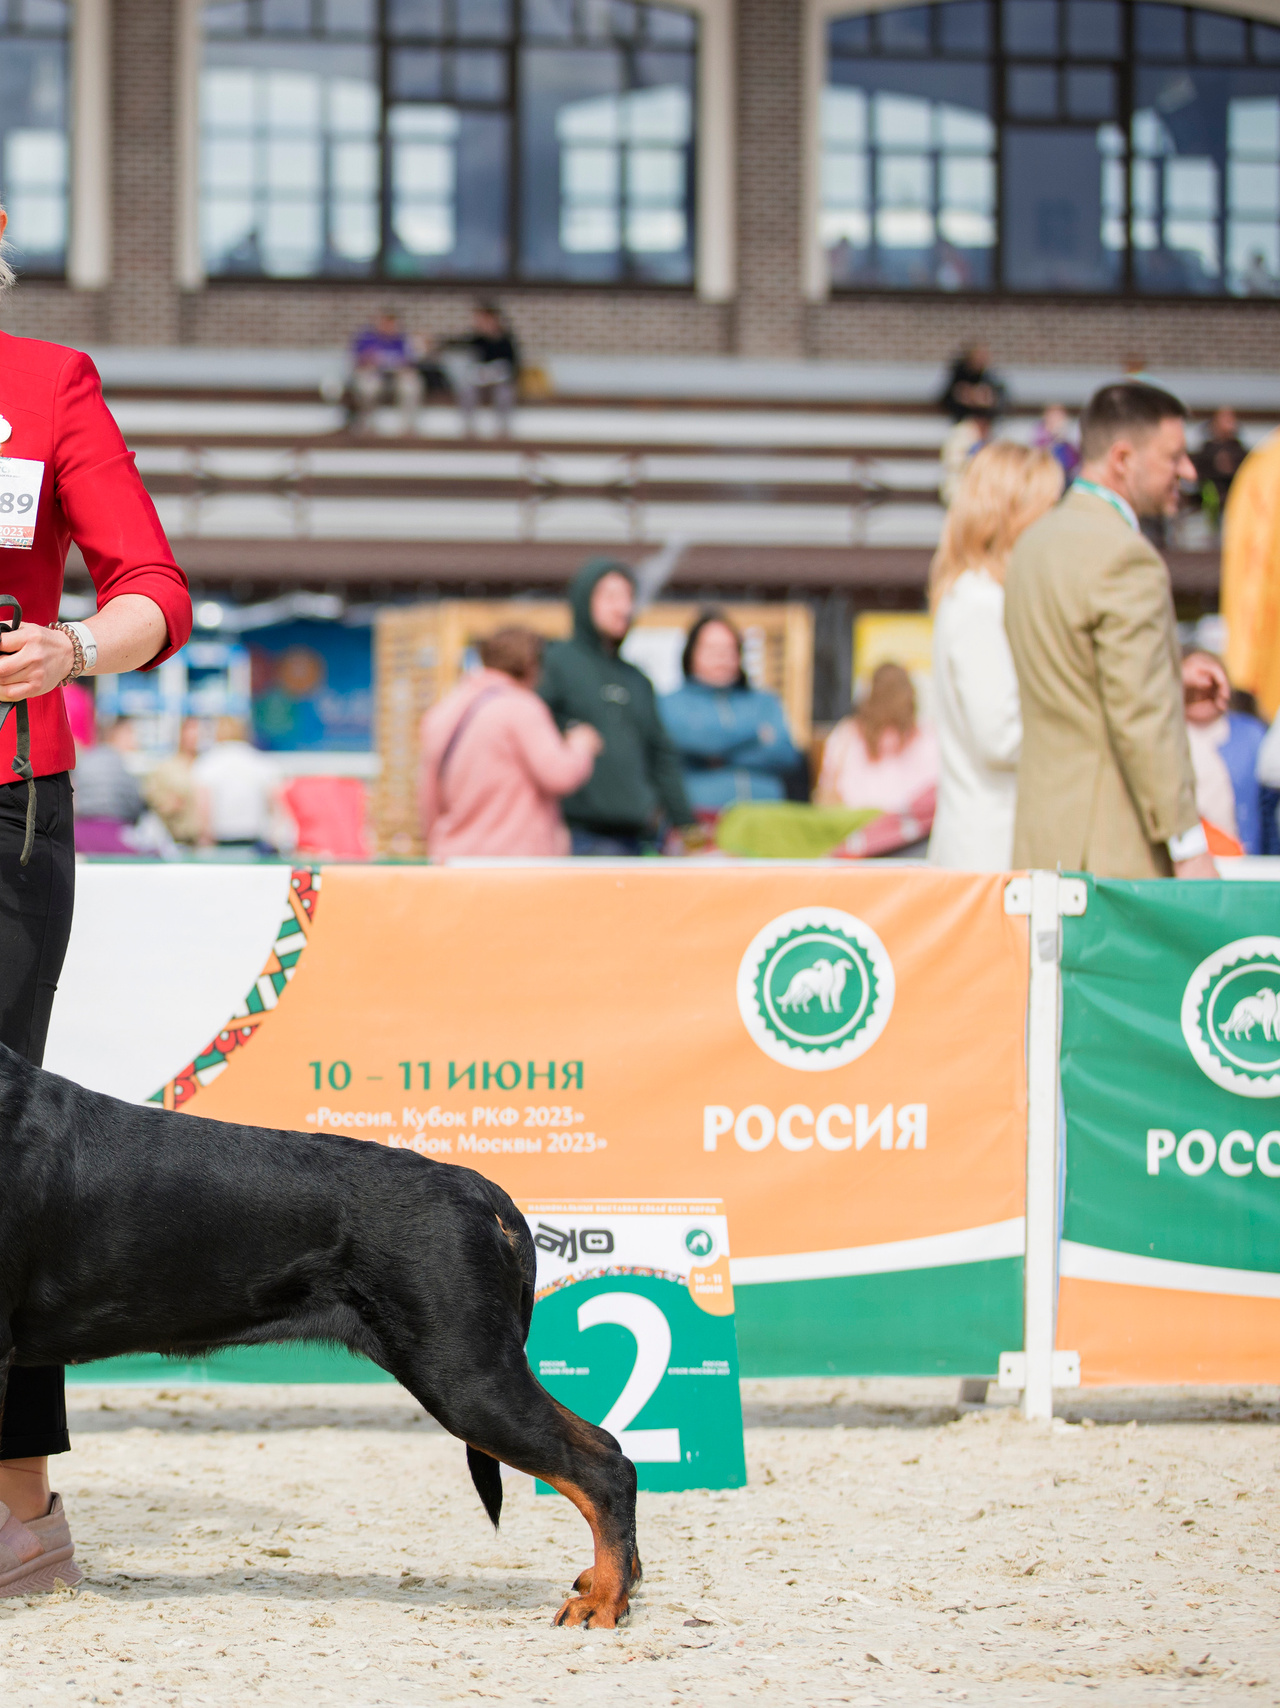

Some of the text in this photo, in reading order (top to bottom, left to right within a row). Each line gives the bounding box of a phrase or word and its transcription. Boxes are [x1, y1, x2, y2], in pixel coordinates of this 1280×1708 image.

[308, 1060, 352, 1091] 10
[398, 1060, 432, 1091] 11
[447, 1060, 584, 1091] ИЮНЯ
[305, 1105, 585, 1131] «Россия. Кубок РКФ 2023»
[703, 1103, 928, 1152] РОССИЯ
[388, 1132, 607, 1153] Кубок Москвы 2023»
[1146, 1128, 1280, 1178] РОСС
[577, 1291, 681, 1463] 2
